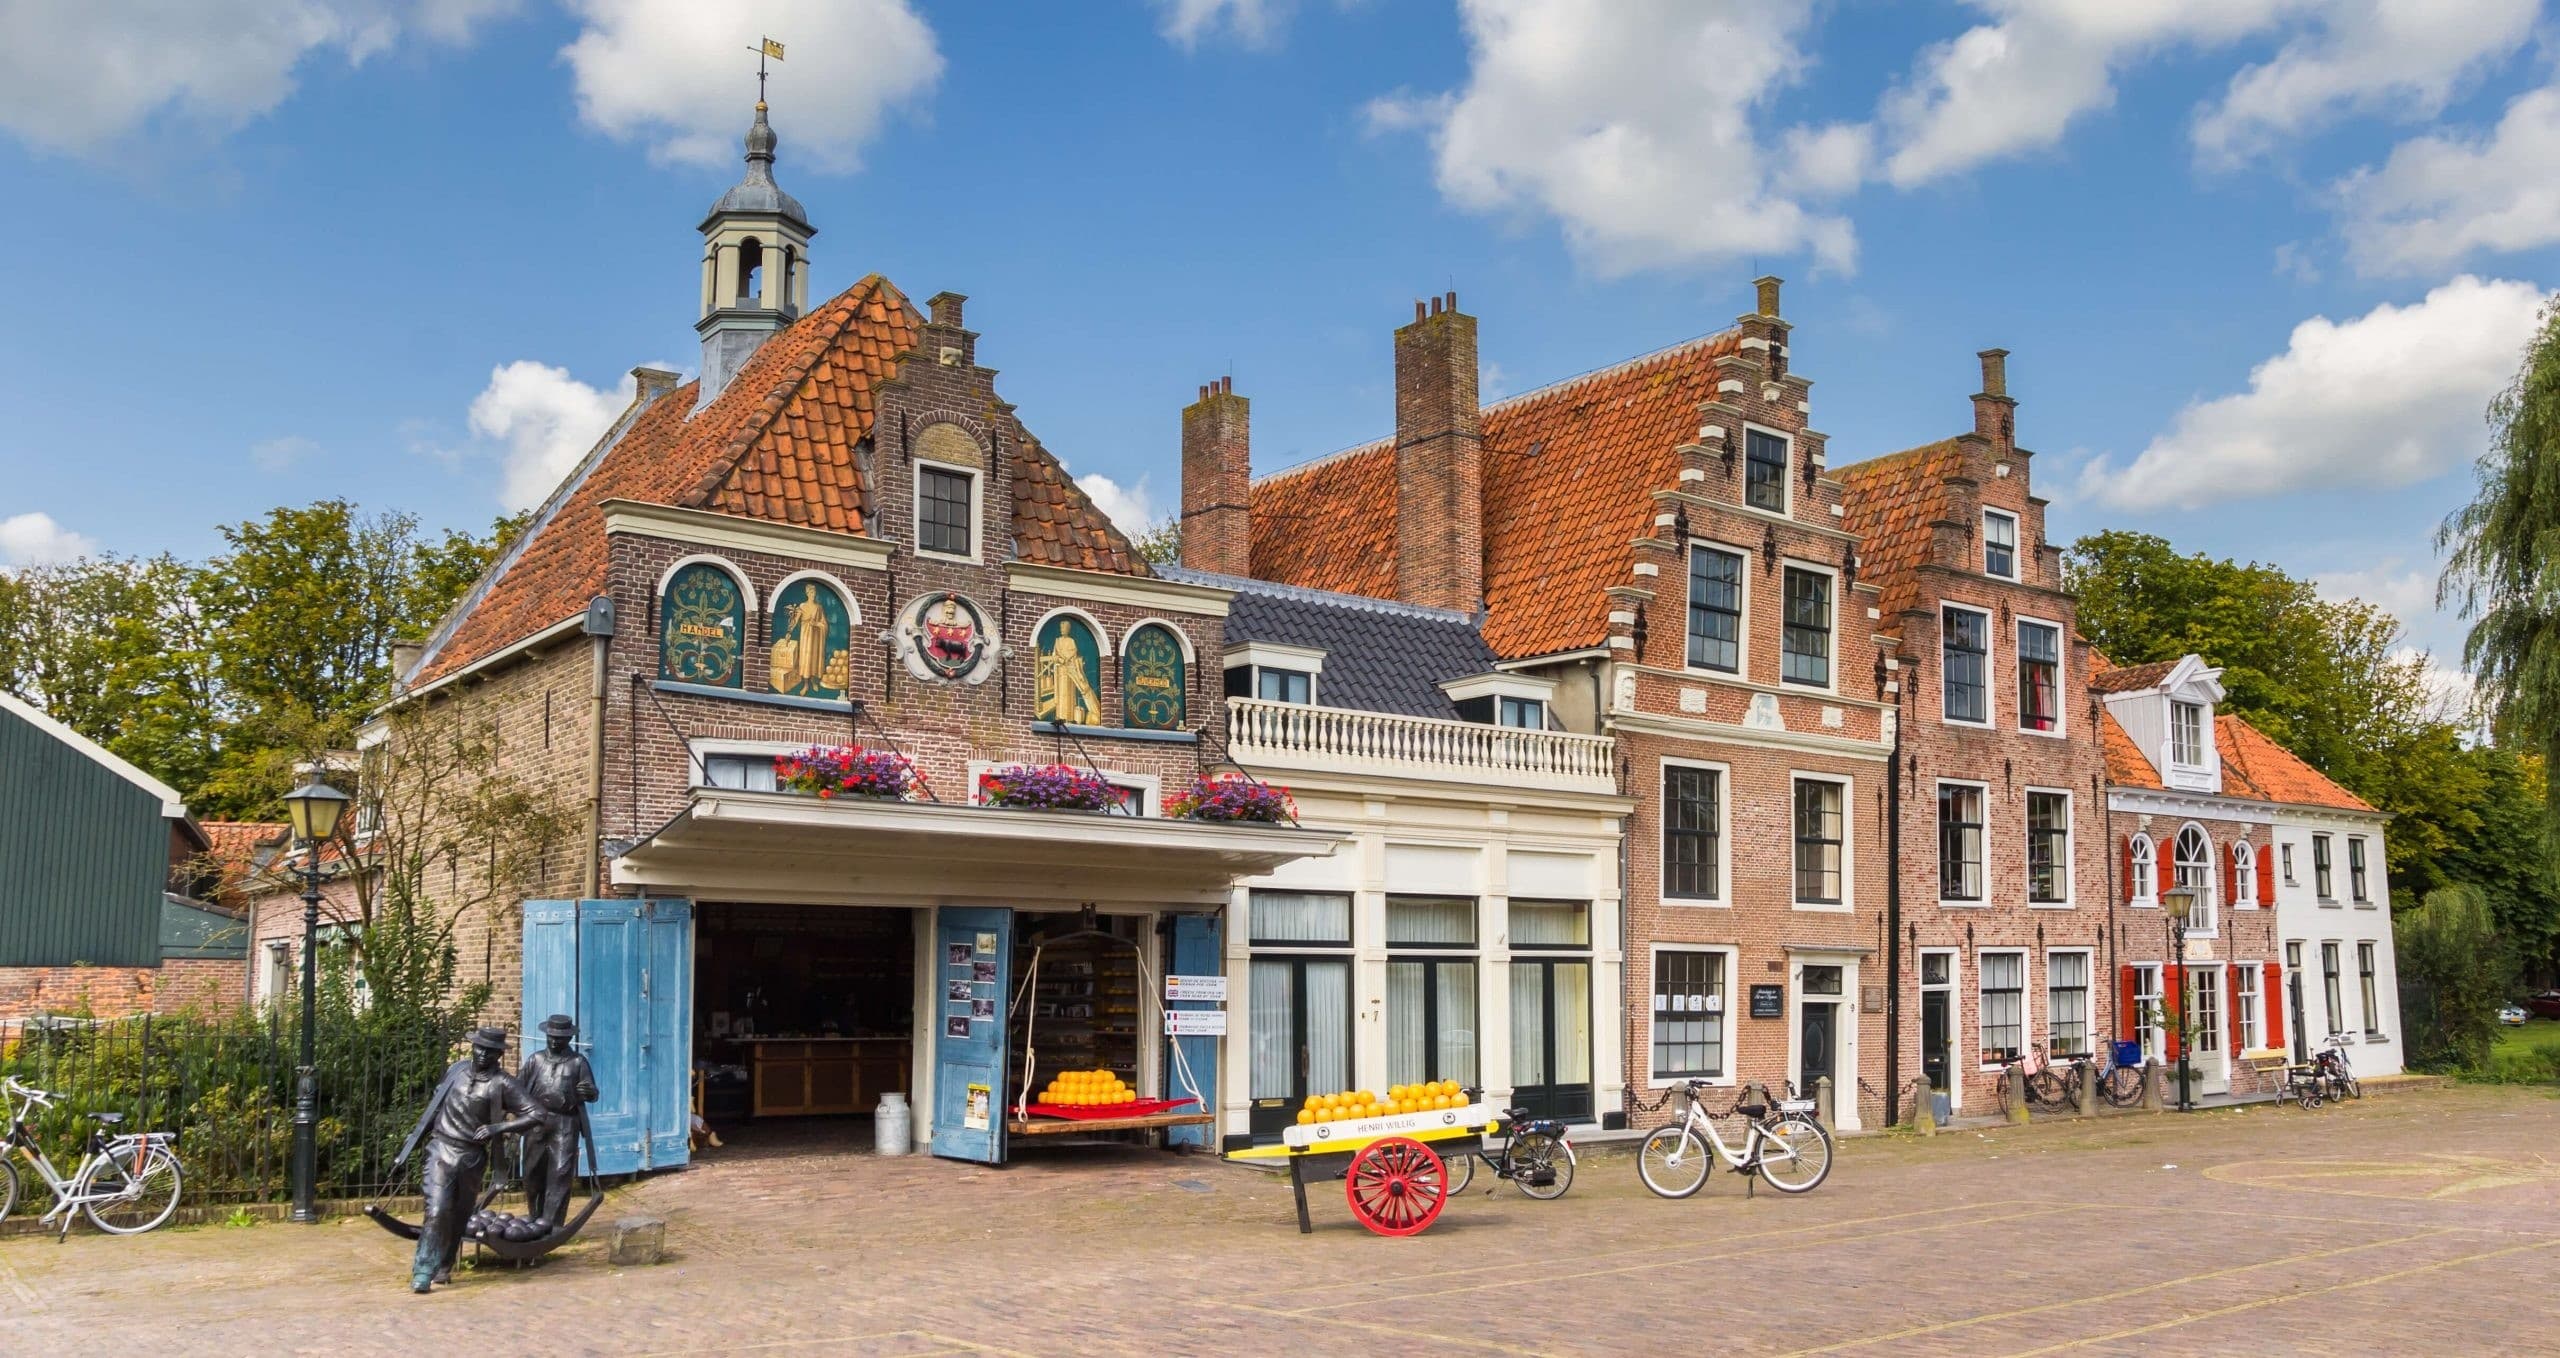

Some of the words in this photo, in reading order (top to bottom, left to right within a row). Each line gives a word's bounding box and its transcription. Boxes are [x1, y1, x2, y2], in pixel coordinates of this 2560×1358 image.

[682, 624, 721, 637] HANDEL
[1358, 1121, 1383, 1133] HENRI
[1386, 1119, 1416, 1129] WILLIG
